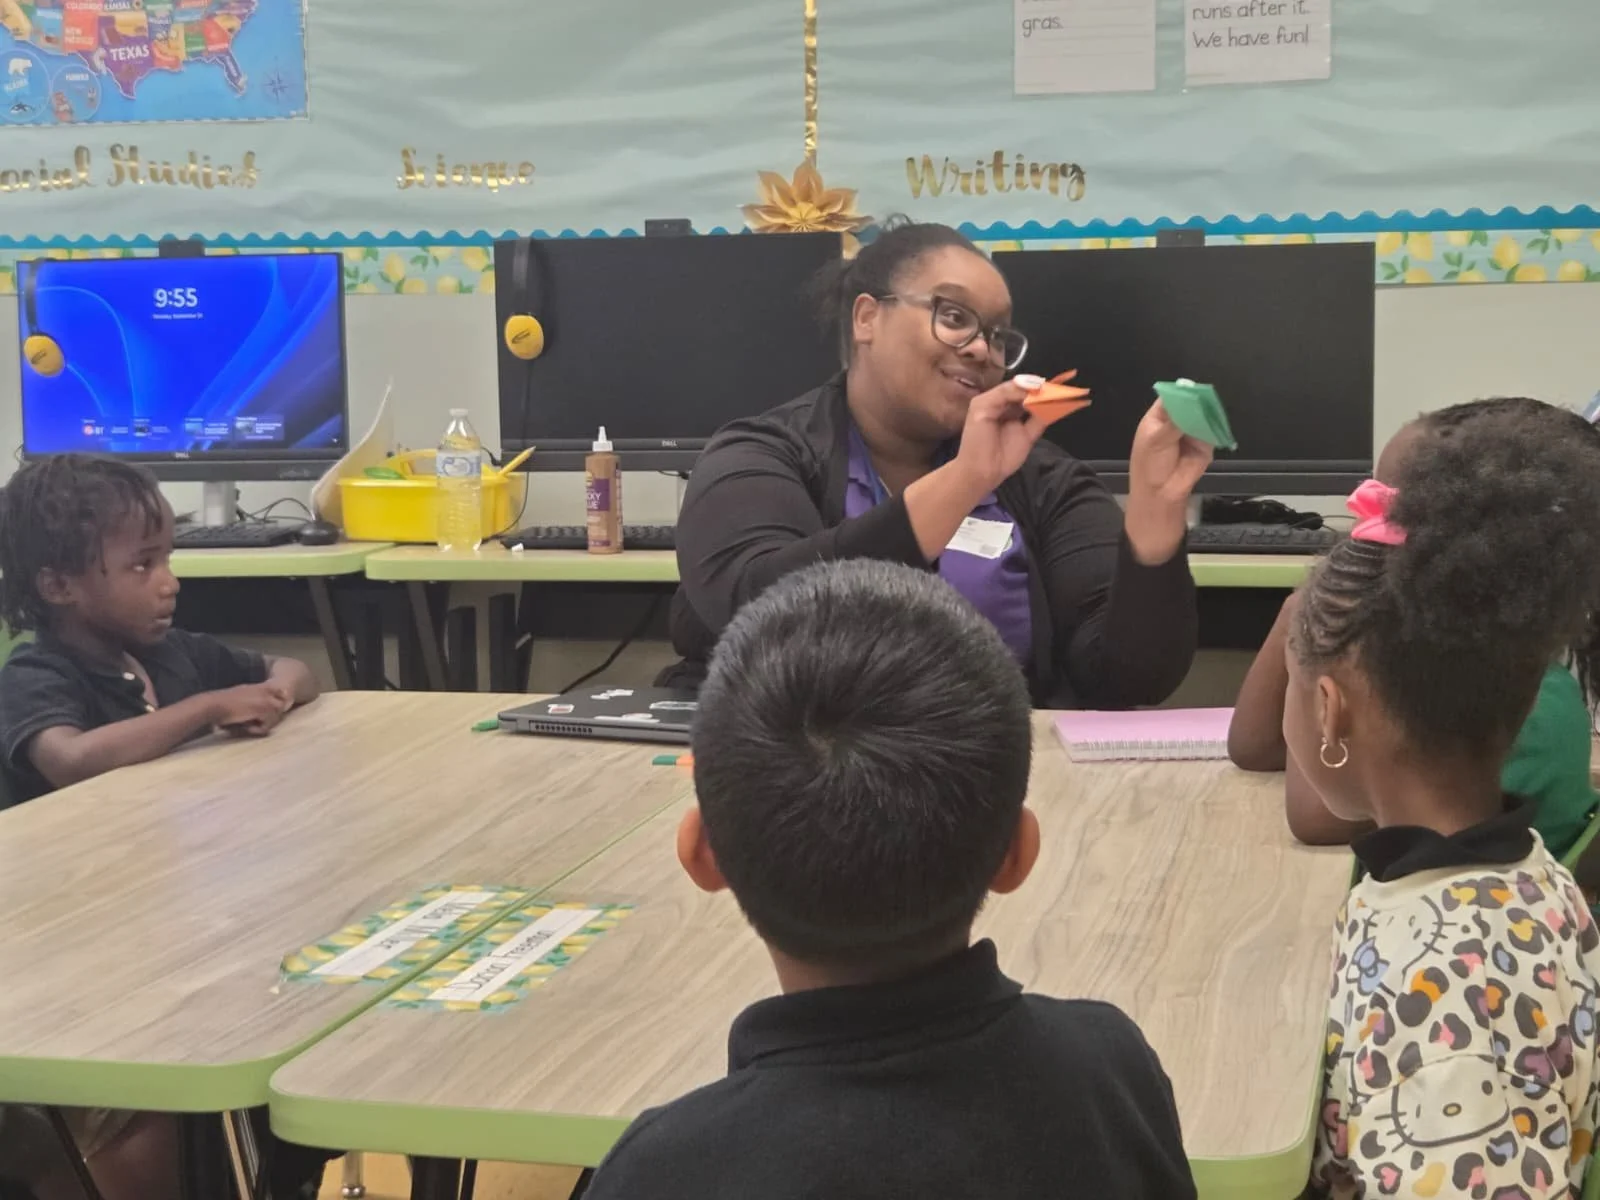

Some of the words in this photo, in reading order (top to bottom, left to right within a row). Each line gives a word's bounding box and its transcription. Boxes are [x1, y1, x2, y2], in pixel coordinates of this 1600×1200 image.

[1192, 5, 1232, 20] runs
[1236, 0, 1288, 18] after
[1192, 31, 1222, 48] We
[1227, 26, 1270, 47] have
[109, 44, 150, 61] TEXAS
[108, 143, 263, 189] Studies
[396, 147, 536, 192] Science
[905, 150, 1087, 202] Writing
[155, 288, 198, 307] 9:55
